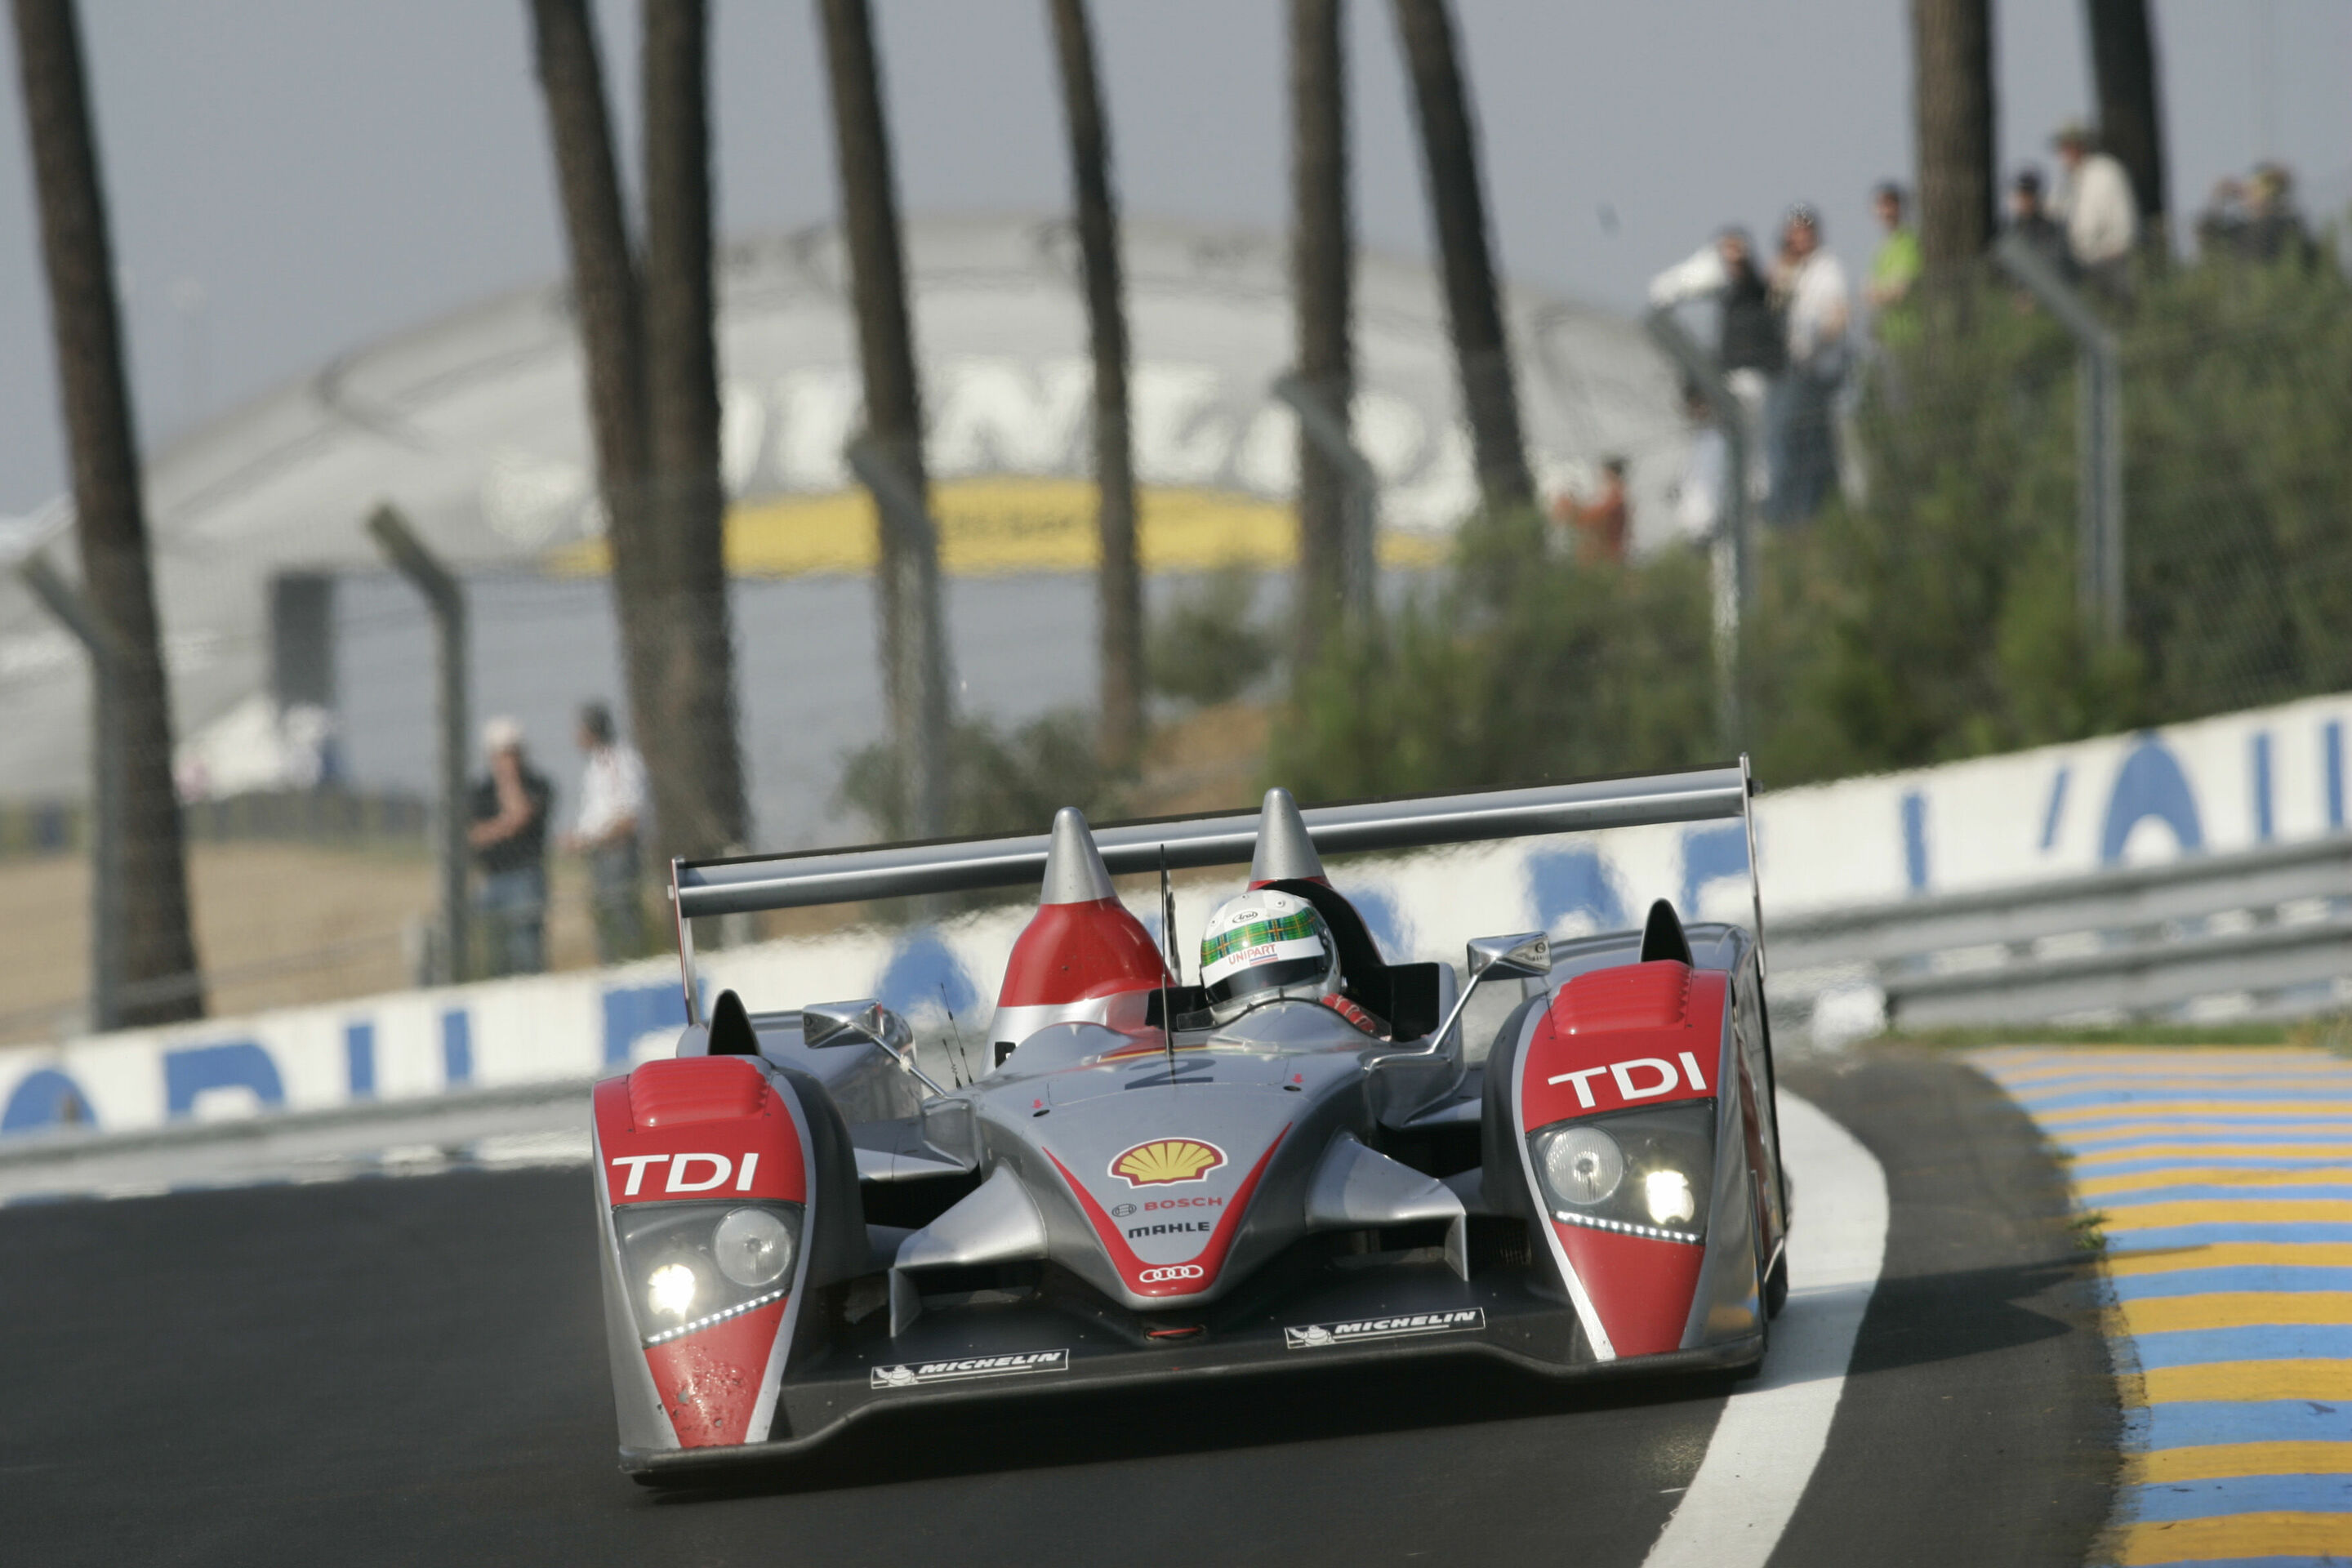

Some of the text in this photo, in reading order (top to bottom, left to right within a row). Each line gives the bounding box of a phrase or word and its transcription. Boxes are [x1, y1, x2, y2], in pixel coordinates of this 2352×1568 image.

[1238, 911, 1255, 920] Arai
[1228, 944, 1276, 964] UNIPART
[1124, 1057, 1216, 1092] 2
[1548, 1051, 1708, 1109] TDI
[612, 1152, 760, 1196] TDI
[1144, 1196, 1223, 1212] BOSCH
[1129, 1221, 1210, 1239] MAHLE
[1334, 1311, 1477, 1334] MICHELIN
[919, 1352, 1062, 1374] MICHELIN
